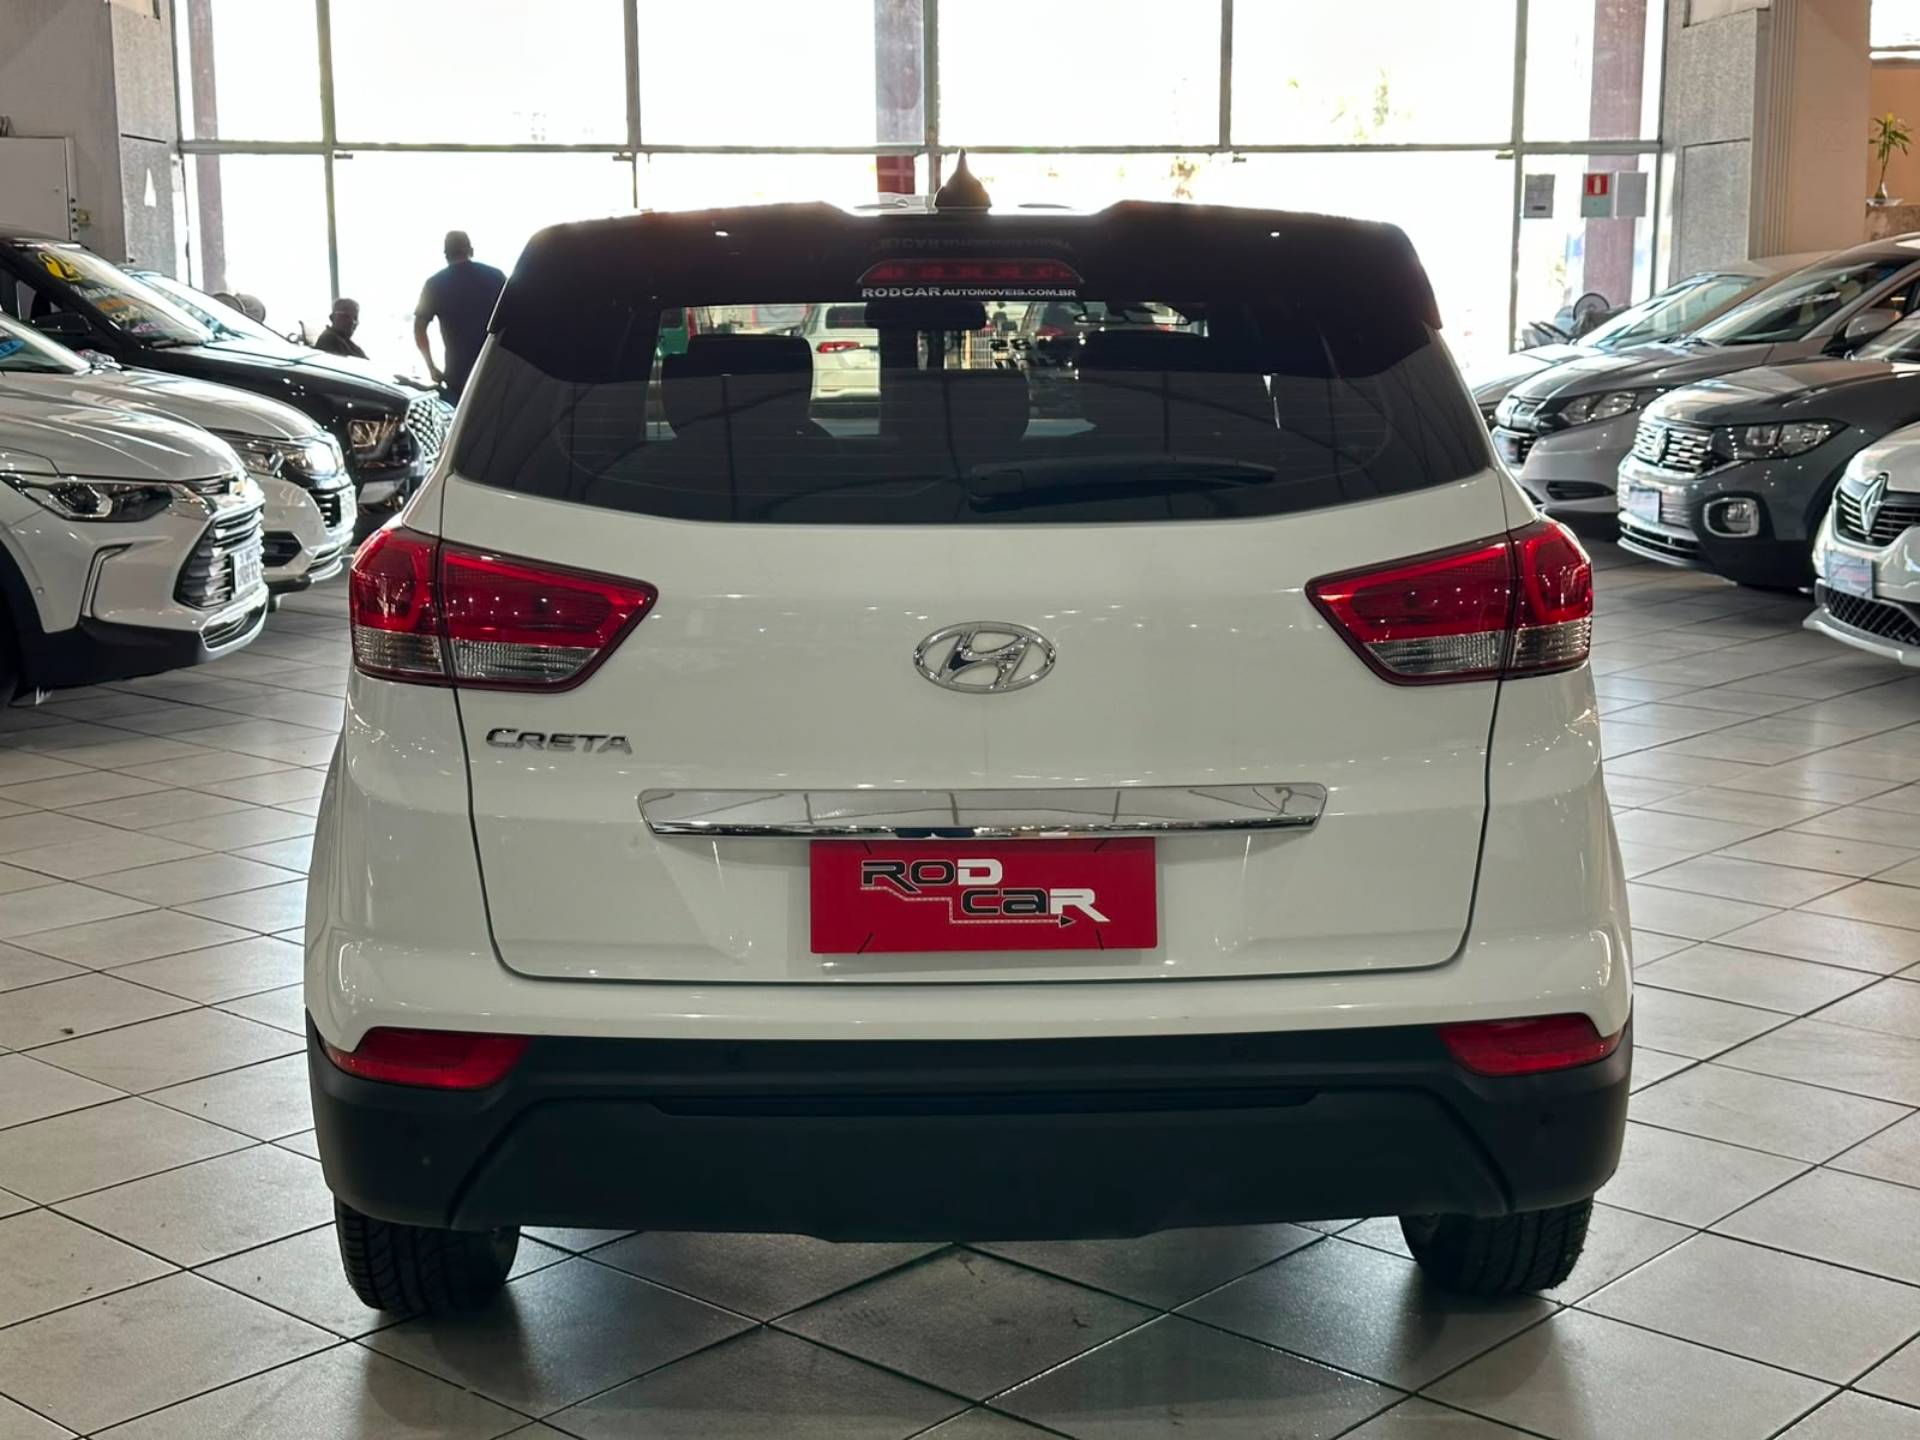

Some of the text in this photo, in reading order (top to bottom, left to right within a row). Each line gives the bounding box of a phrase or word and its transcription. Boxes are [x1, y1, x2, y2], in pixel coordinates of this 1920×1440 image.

[861, 286, 941, 298] RODCAR
[486, 728, 632, 754] CRETA
[861, 859, 1003, 894] ROD
